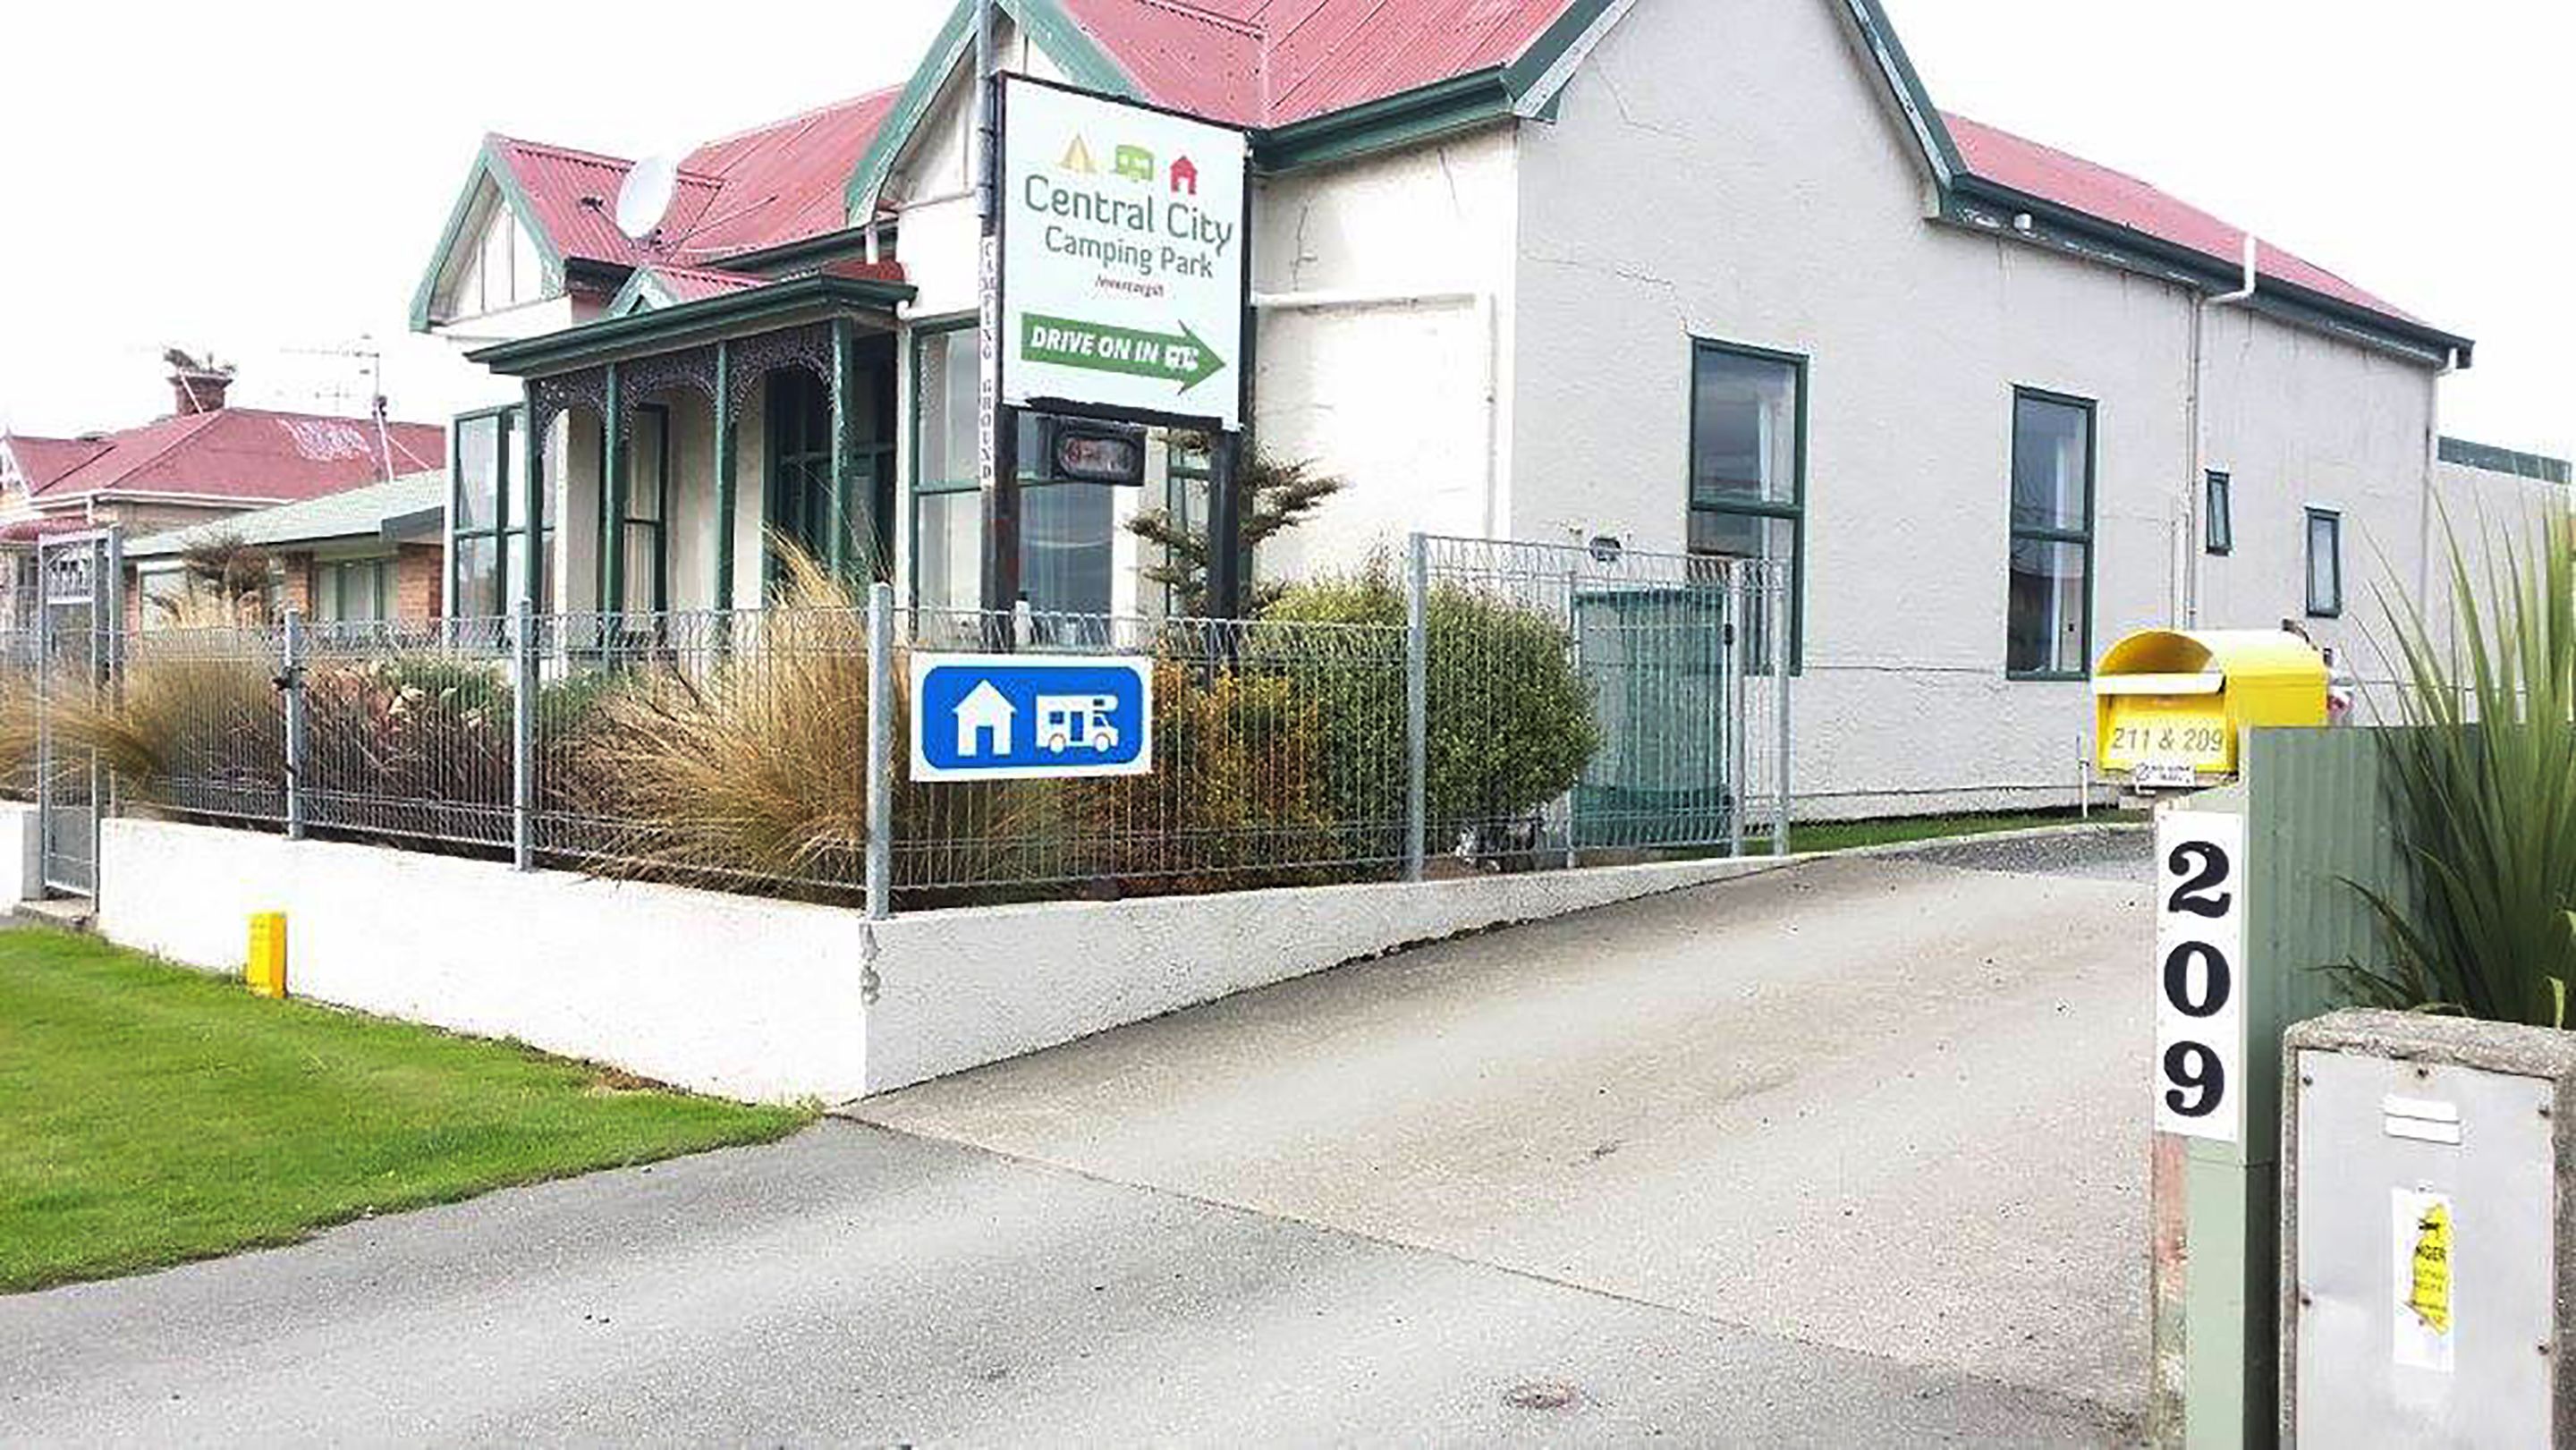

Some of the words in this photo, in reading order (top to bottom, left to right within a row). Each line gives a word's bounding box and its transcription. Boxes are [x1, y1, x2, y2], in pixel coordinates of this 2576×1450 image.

[1025, 174, 1155, 233] Central
[1167, 203, 1233, 258] City
[1046, 225, 1154, 276] Camping
[1162, 247, 1214, 279] Park
[1030, 326, 1094, 358] DRIVE
[1098, 335, 1132, 361] ON
[1134, 341, 1160, 364] IN
[2112, 727, 2150, 750] 211
[2158, 728, 2174, 751] &
[2183, 728, 2224, 752] 209
[2163, 840, 2232, 1118] 209
